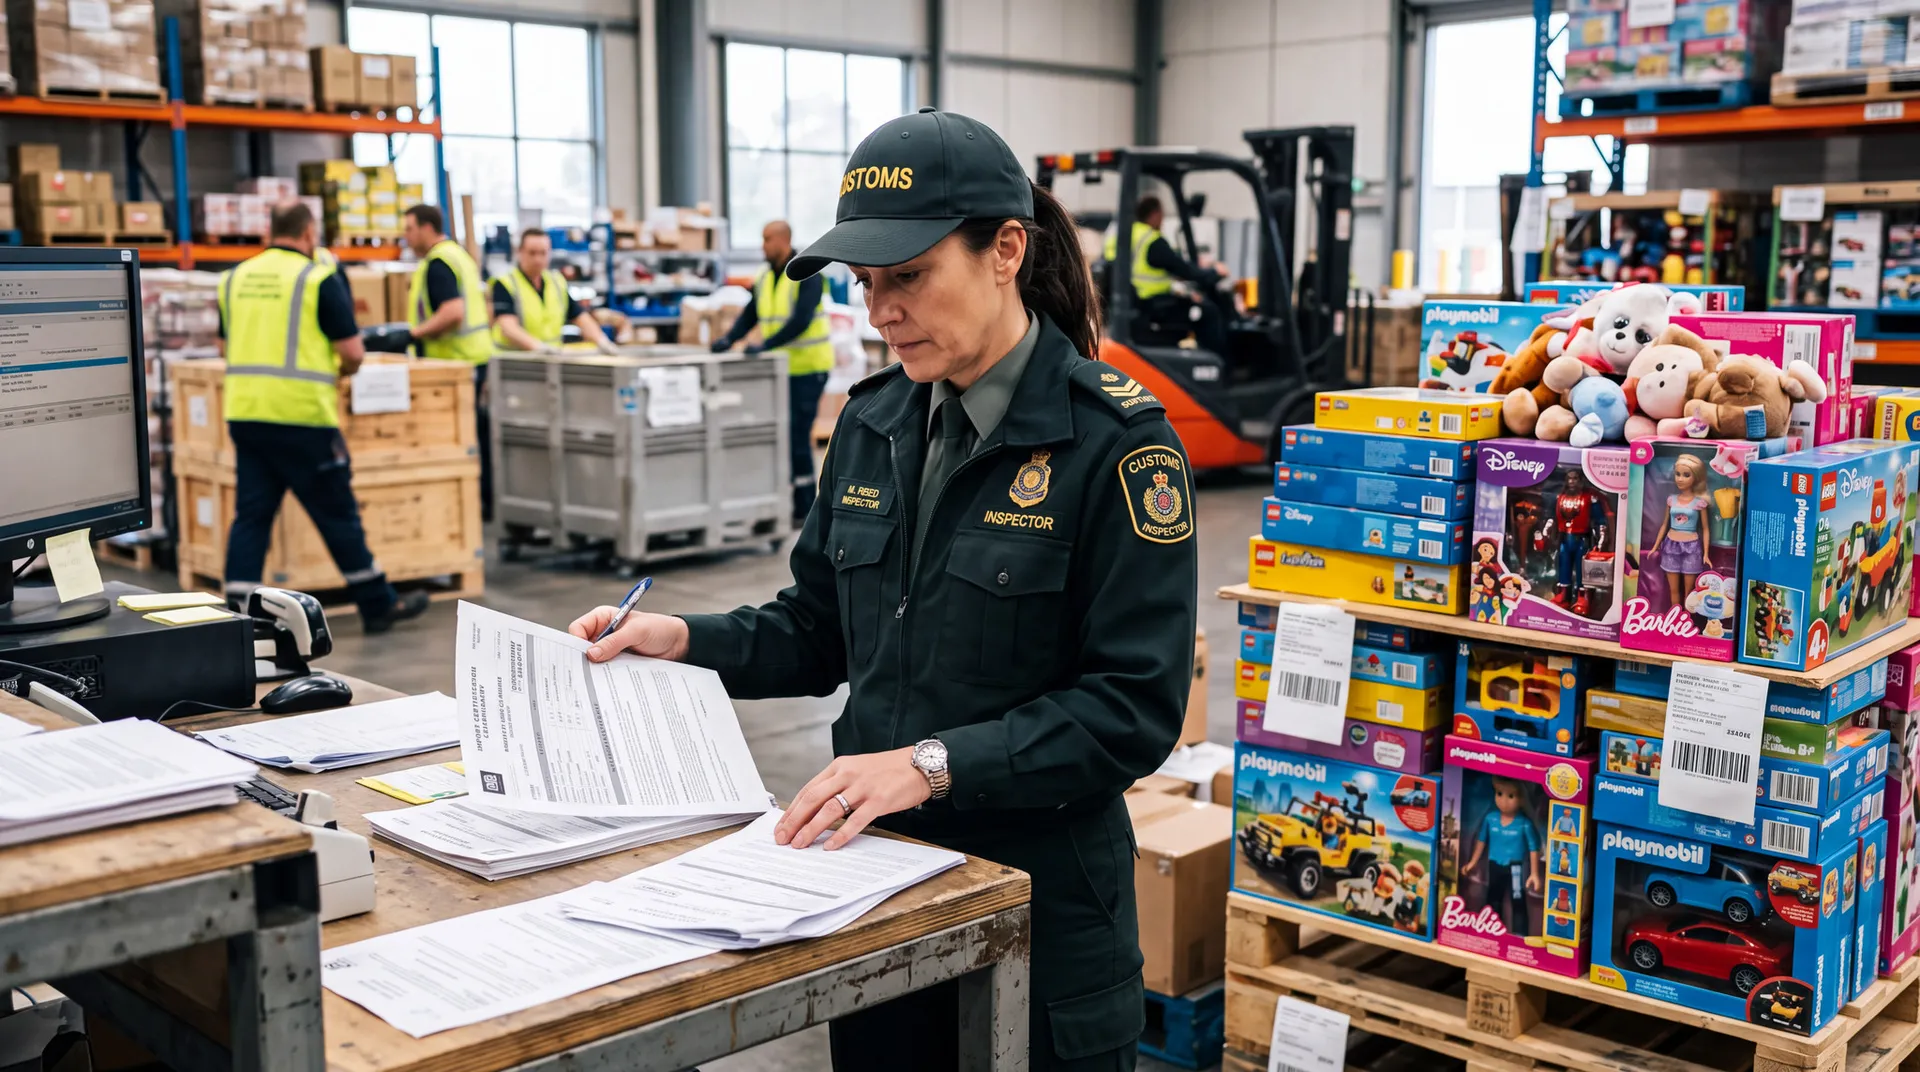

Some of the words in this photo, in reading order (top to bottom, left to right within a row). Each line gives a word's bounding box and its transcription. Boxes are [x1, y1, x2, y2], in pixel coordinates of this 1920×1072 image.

[1425, 306, 1500, 326] playmobil
[1128, 453, 1180, 474] CUSTOMS
[1483, 448, 1546, 480] Disney
[841, 495, 880, 509] INSPECTOR
[983, 510, 1054, 531] INSPECTOR
[1142, 521, 1189, 537] INSPECTOR
[1793, 498, 1809, 557] playmobil
[1622, 597, 1699, 638] Barbie
[1808, 629, 1827, 660] 4+
[1240, 751, 1327, 783] playmobil
[1598, 781, 1644, 797] playmobil
[1602, 830, 1704, 865] playmobil
[1441, 896, 1507, 936] Barbie
